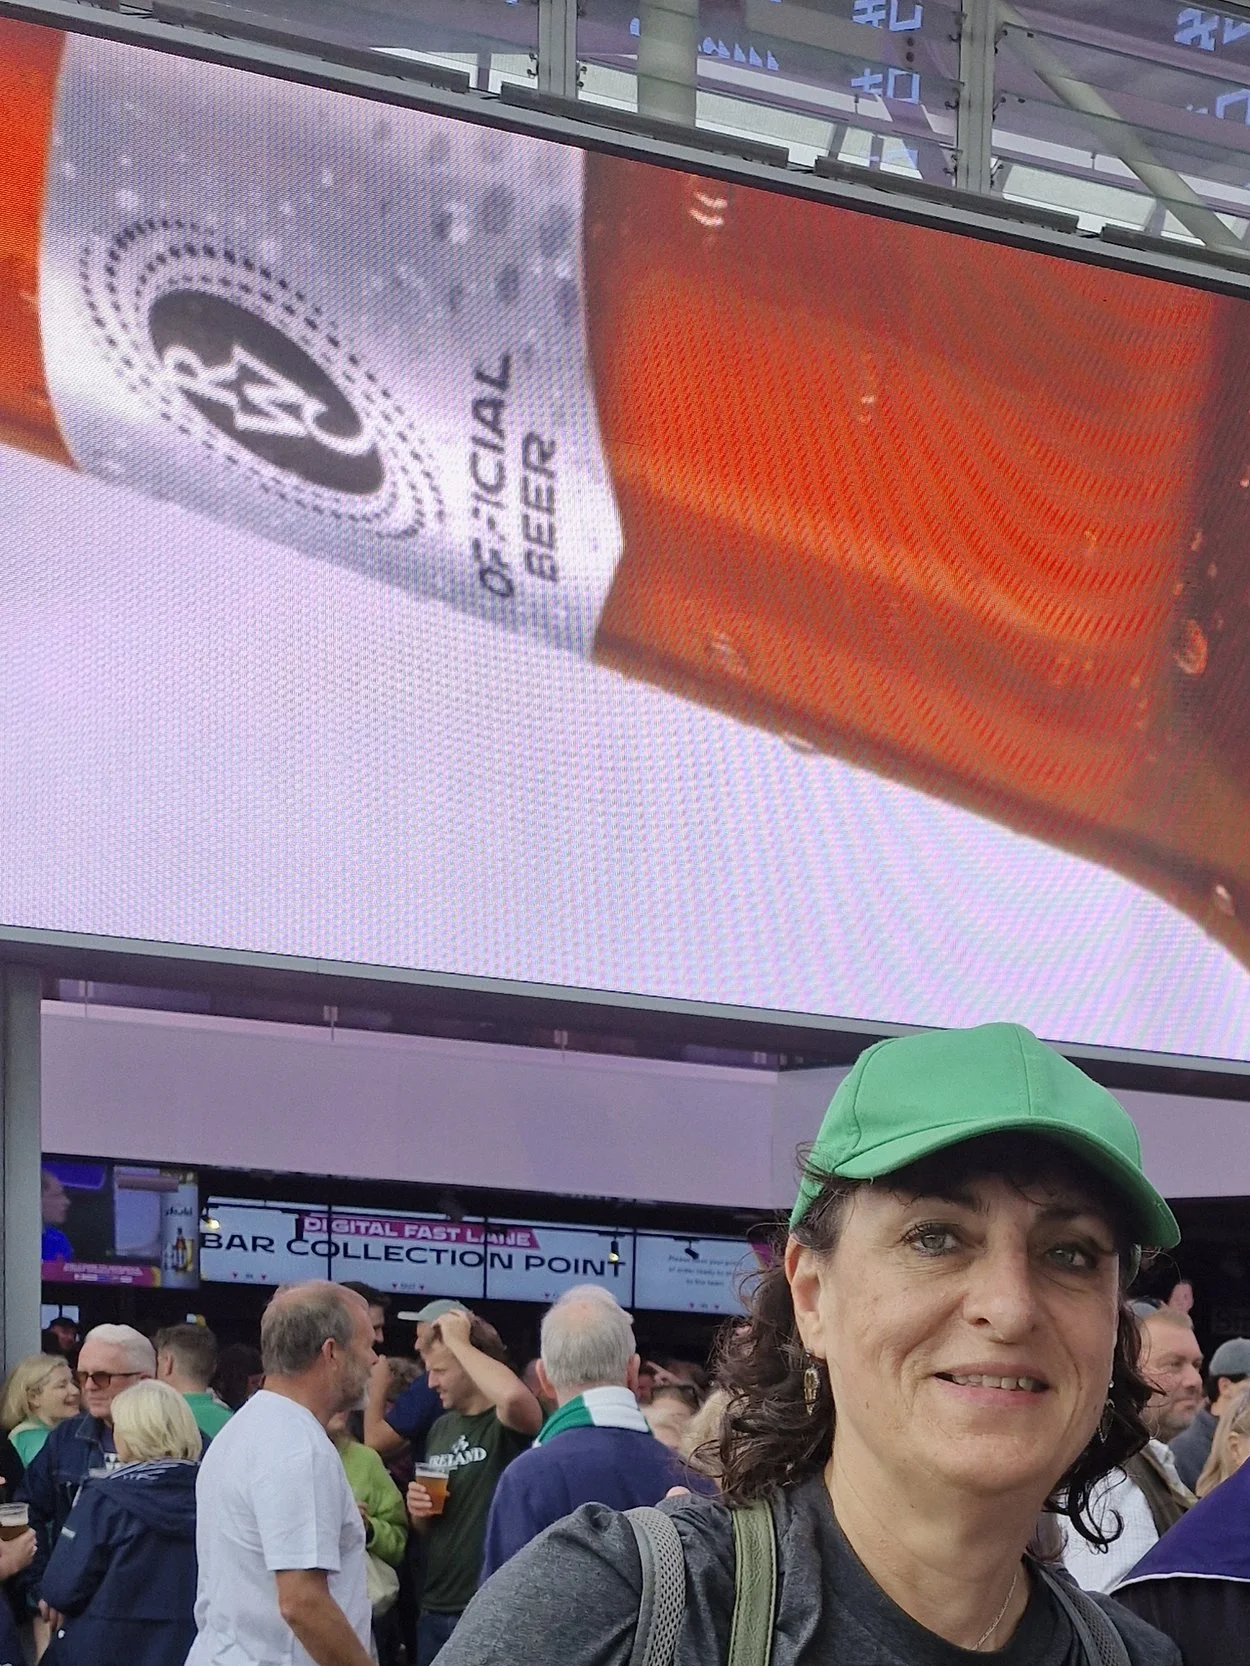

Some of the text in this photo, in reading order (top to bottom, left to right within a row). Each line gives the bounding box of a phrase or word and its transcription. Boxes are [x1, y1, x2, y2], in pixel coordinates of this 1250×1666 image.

[520, 432, 559, 583] BEER
[303, 1216, 399, 1238] DIGITAL
[403, 1224, 461, 1242] FAST
[201, 1232, 627, 1278] BAR COLLECTION POINT
